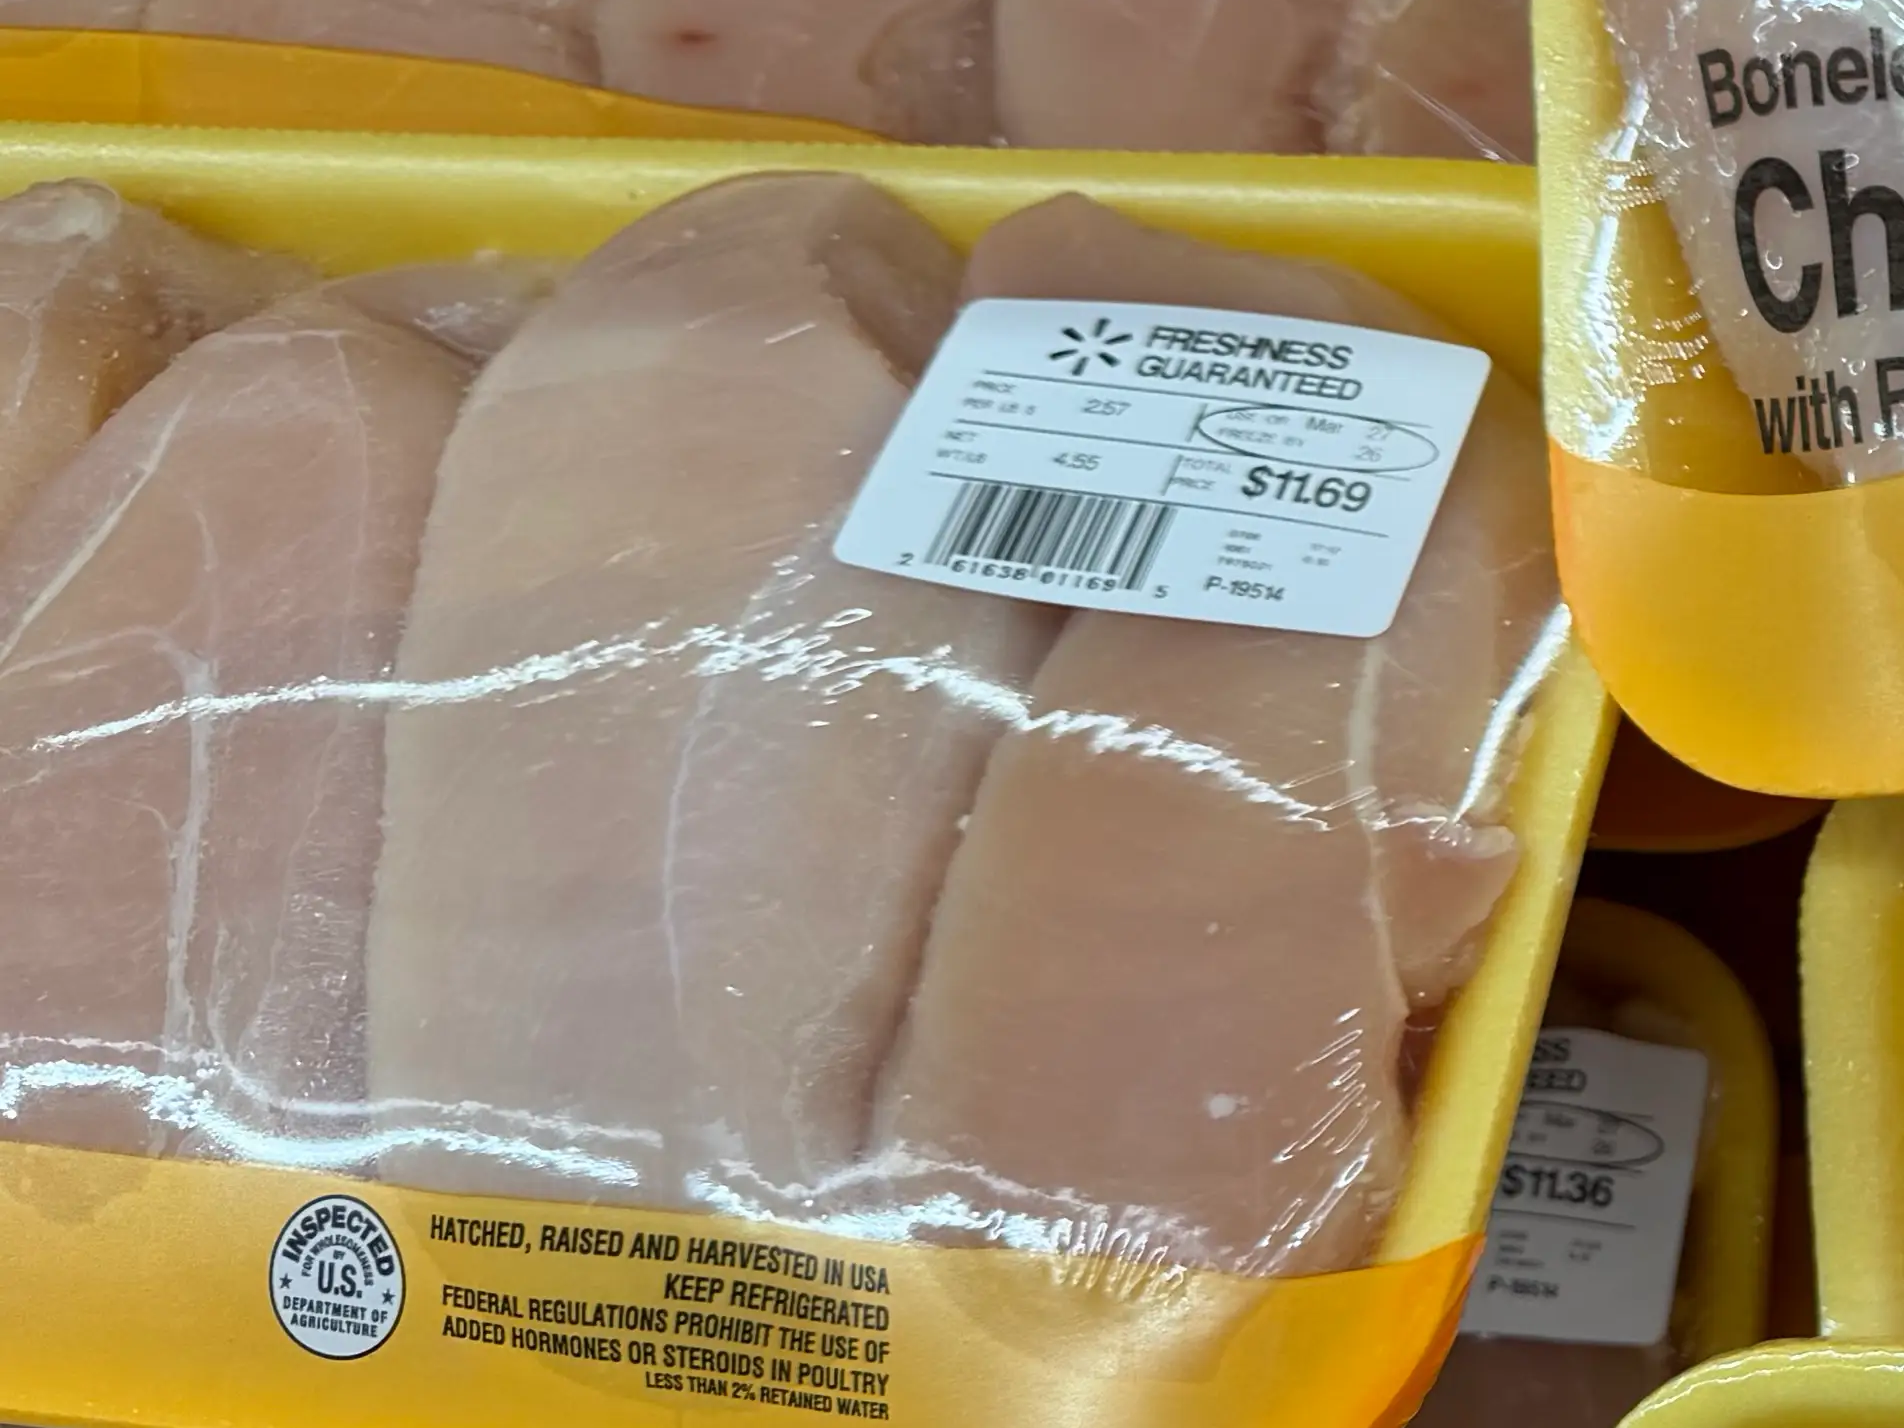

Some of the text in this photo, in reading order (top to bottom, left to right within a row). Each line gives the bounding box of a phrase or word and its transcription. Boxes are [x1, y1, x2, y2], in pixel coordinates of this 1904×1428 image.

[1148, 326, 1352, 370] FRESHNESS
[1138, 355, 1362, 400] GUARANTEED
[1755, 372, 1860, 457] with
[1241, 464, 1372, 512] $11.69
[1204, 576, 1286, 601] P-19514
[281, 1205, 395, 1278] INSPECTED
[430, 1214, 889, 1294] HATCHED, RAISED AND HARVESTED IN USA
[317, 1258, 363, 1299] U.S.
